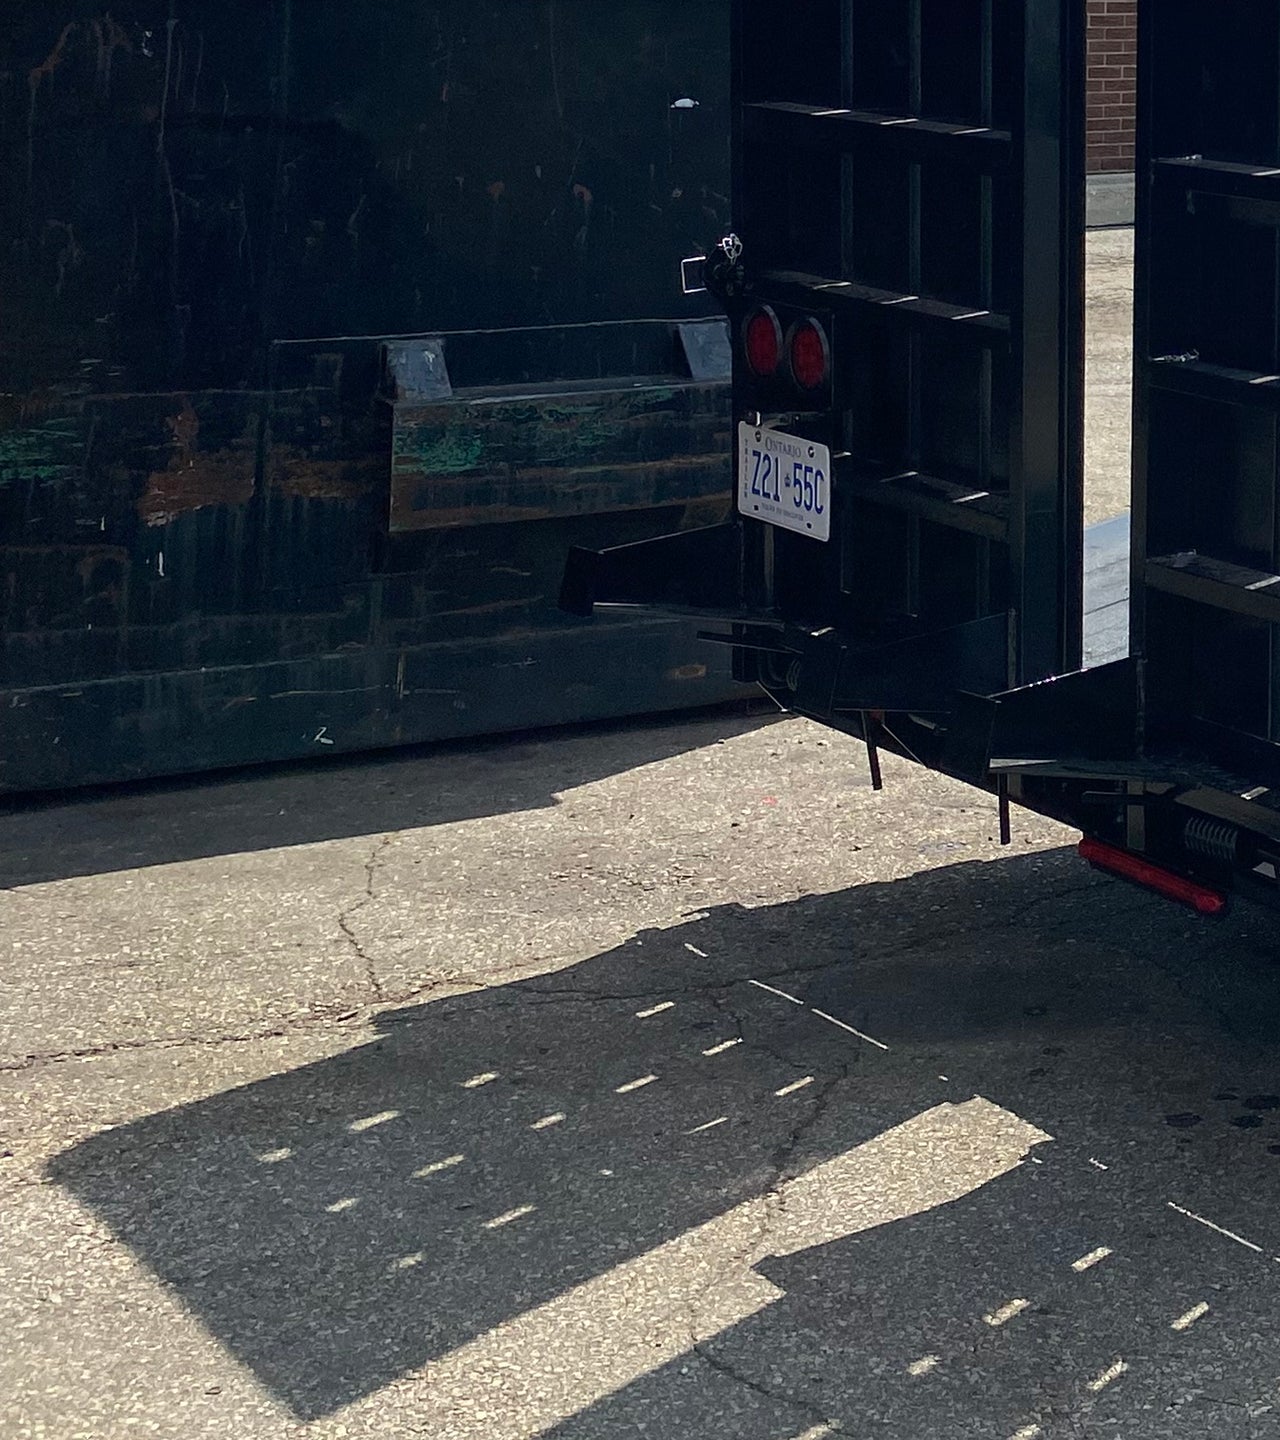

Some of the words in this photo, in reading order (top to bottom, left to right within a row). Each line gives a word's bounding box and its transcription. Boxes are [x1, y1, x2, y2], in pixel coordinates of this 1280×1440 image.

[765, 436, 802, 458] ONTARIO
[751, 449, 781, 503] Z21
[793, 462, 825, 515] 55C
